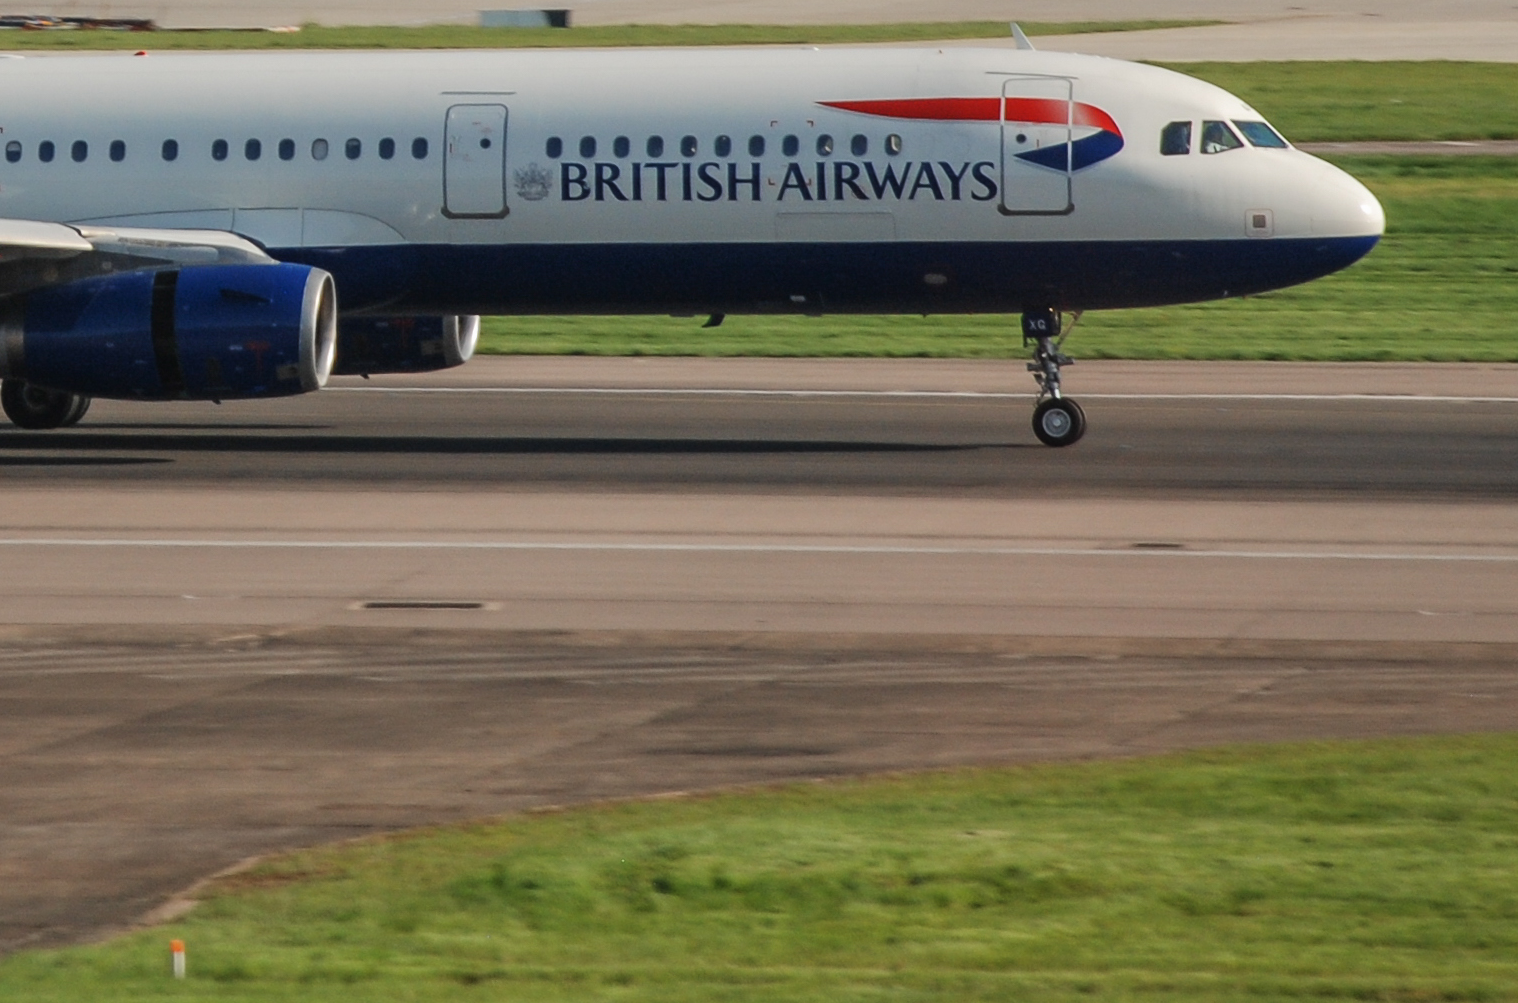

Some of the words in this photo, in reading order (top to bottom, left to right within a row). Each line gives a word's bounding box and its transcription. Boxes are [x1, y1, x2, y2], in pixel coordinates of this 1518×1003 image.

[561, 162, 761, 202] BRITISH
[777, 161, 998, 202] AIRWAYS
[1029, 319, 1046, 330] XG
